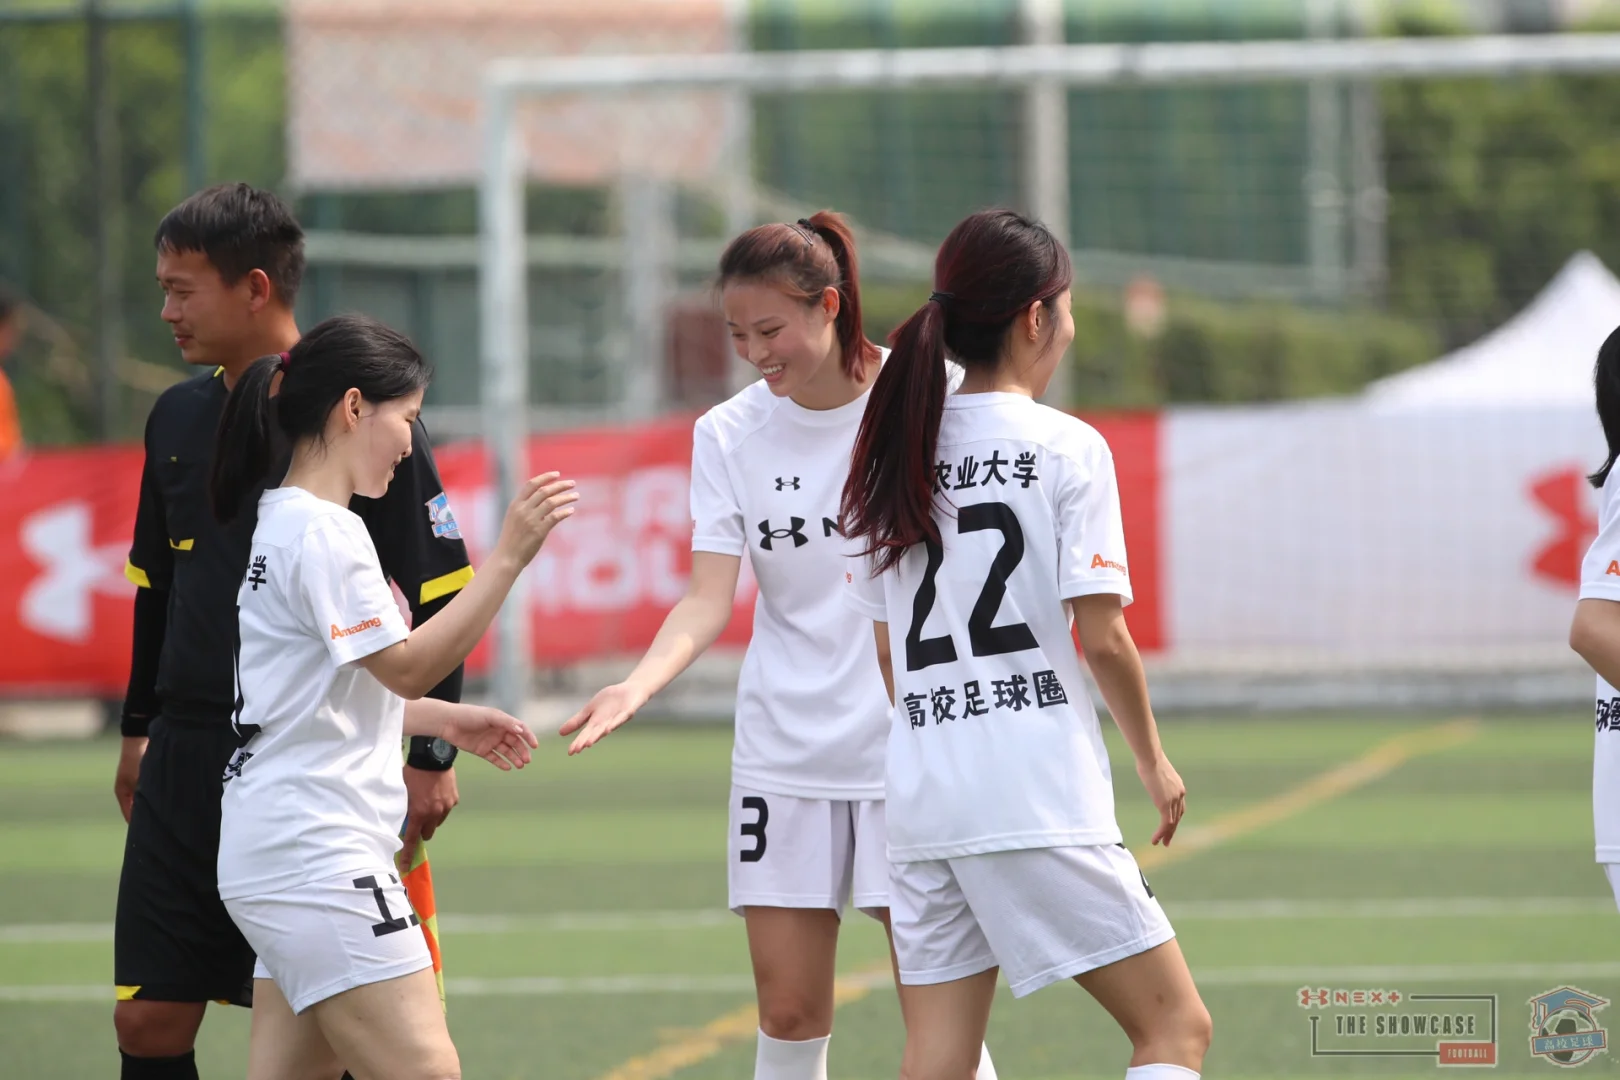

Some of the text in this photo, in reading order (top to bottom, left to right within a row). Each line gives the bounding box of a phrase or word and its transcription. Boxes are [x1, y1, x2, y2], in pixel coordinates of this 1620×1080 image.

[242, 555, 267, 591] 学
[905, 501, 1040, 672] 22
[331, 616, 381, 640] Amazing
[903, 669, 1069, 731] 高校足球圈
[740, 796, 769, 863] 3
